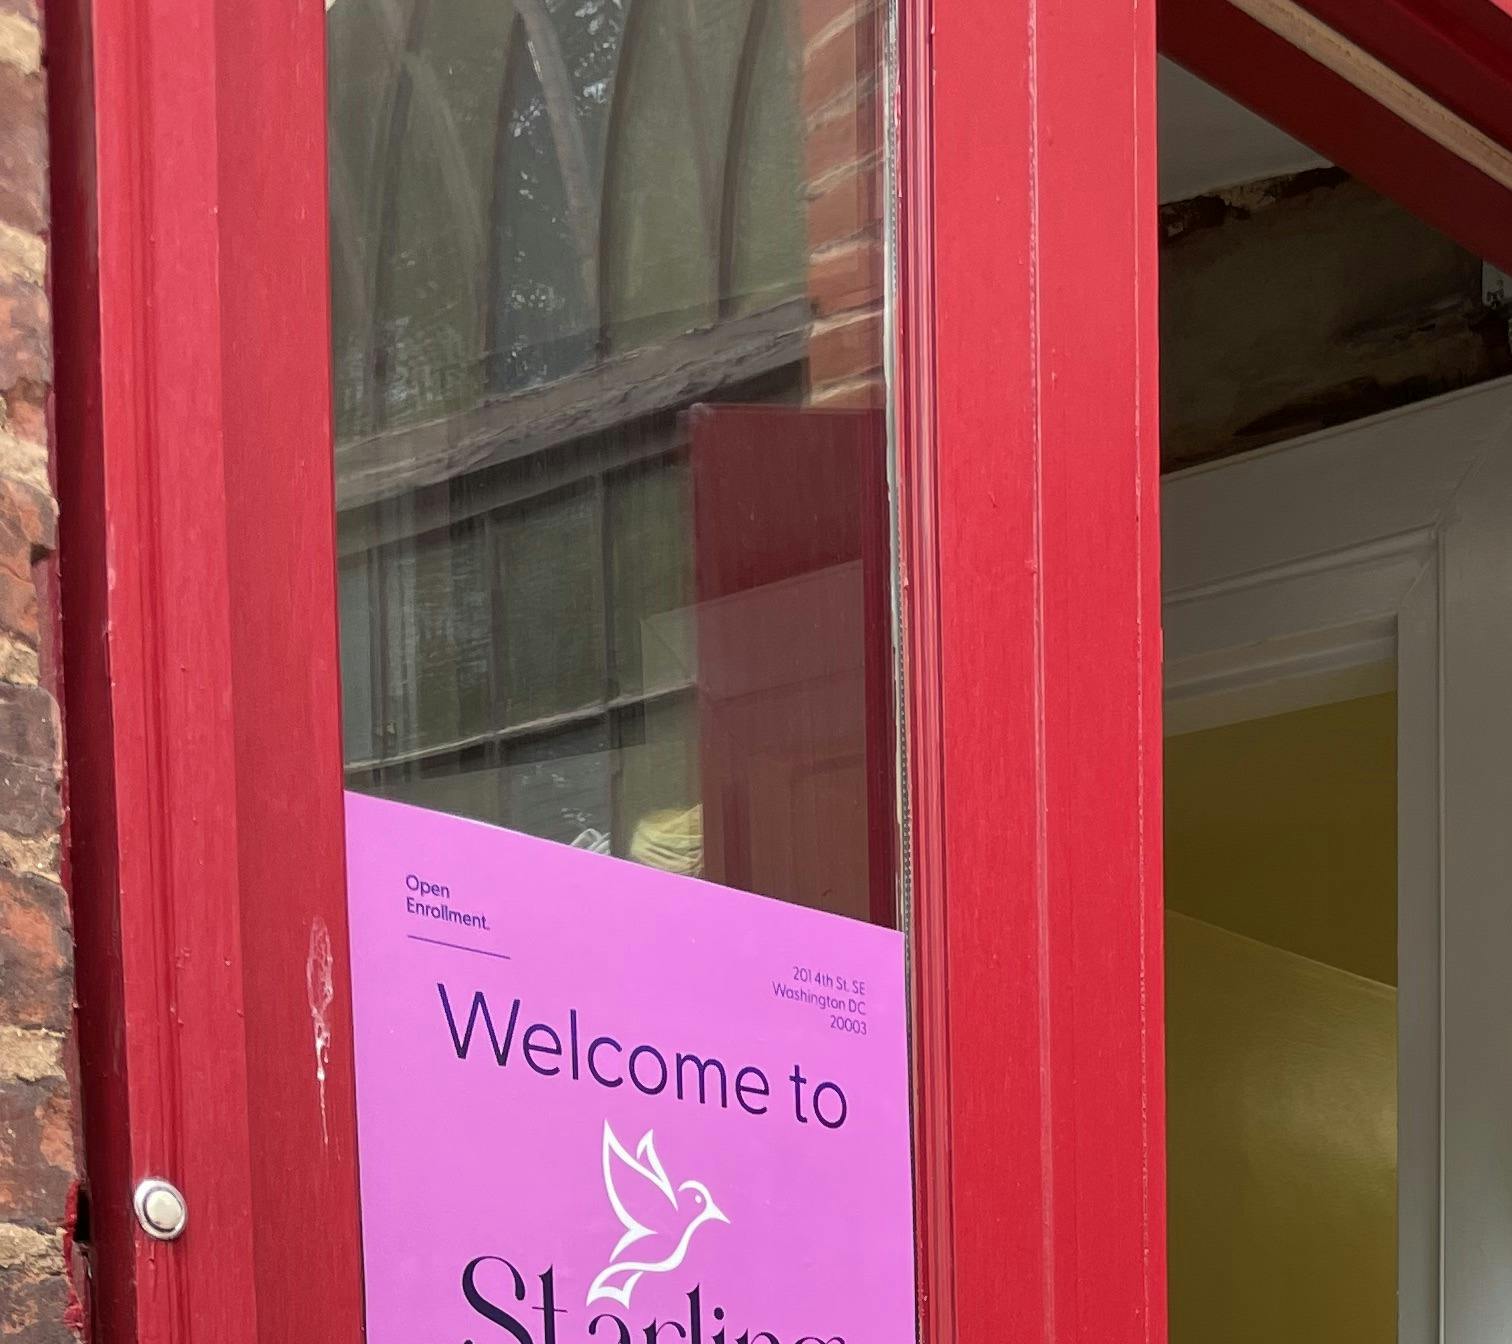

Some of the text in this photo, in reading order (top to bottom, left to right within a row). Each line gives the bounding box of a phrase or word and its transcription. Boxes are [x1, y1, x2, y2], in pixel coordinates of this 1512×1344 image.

[405, 874, 450, 899] Open
[406, 896, 491, 931] Enrollment.
[793, 965, 866, 996] 201 4th St. SE
[772, 980, 867, 1015] Washington DC
[830, 1014, 867, 1036] 20003
[436, 982, 848, 1129] Welcome to
